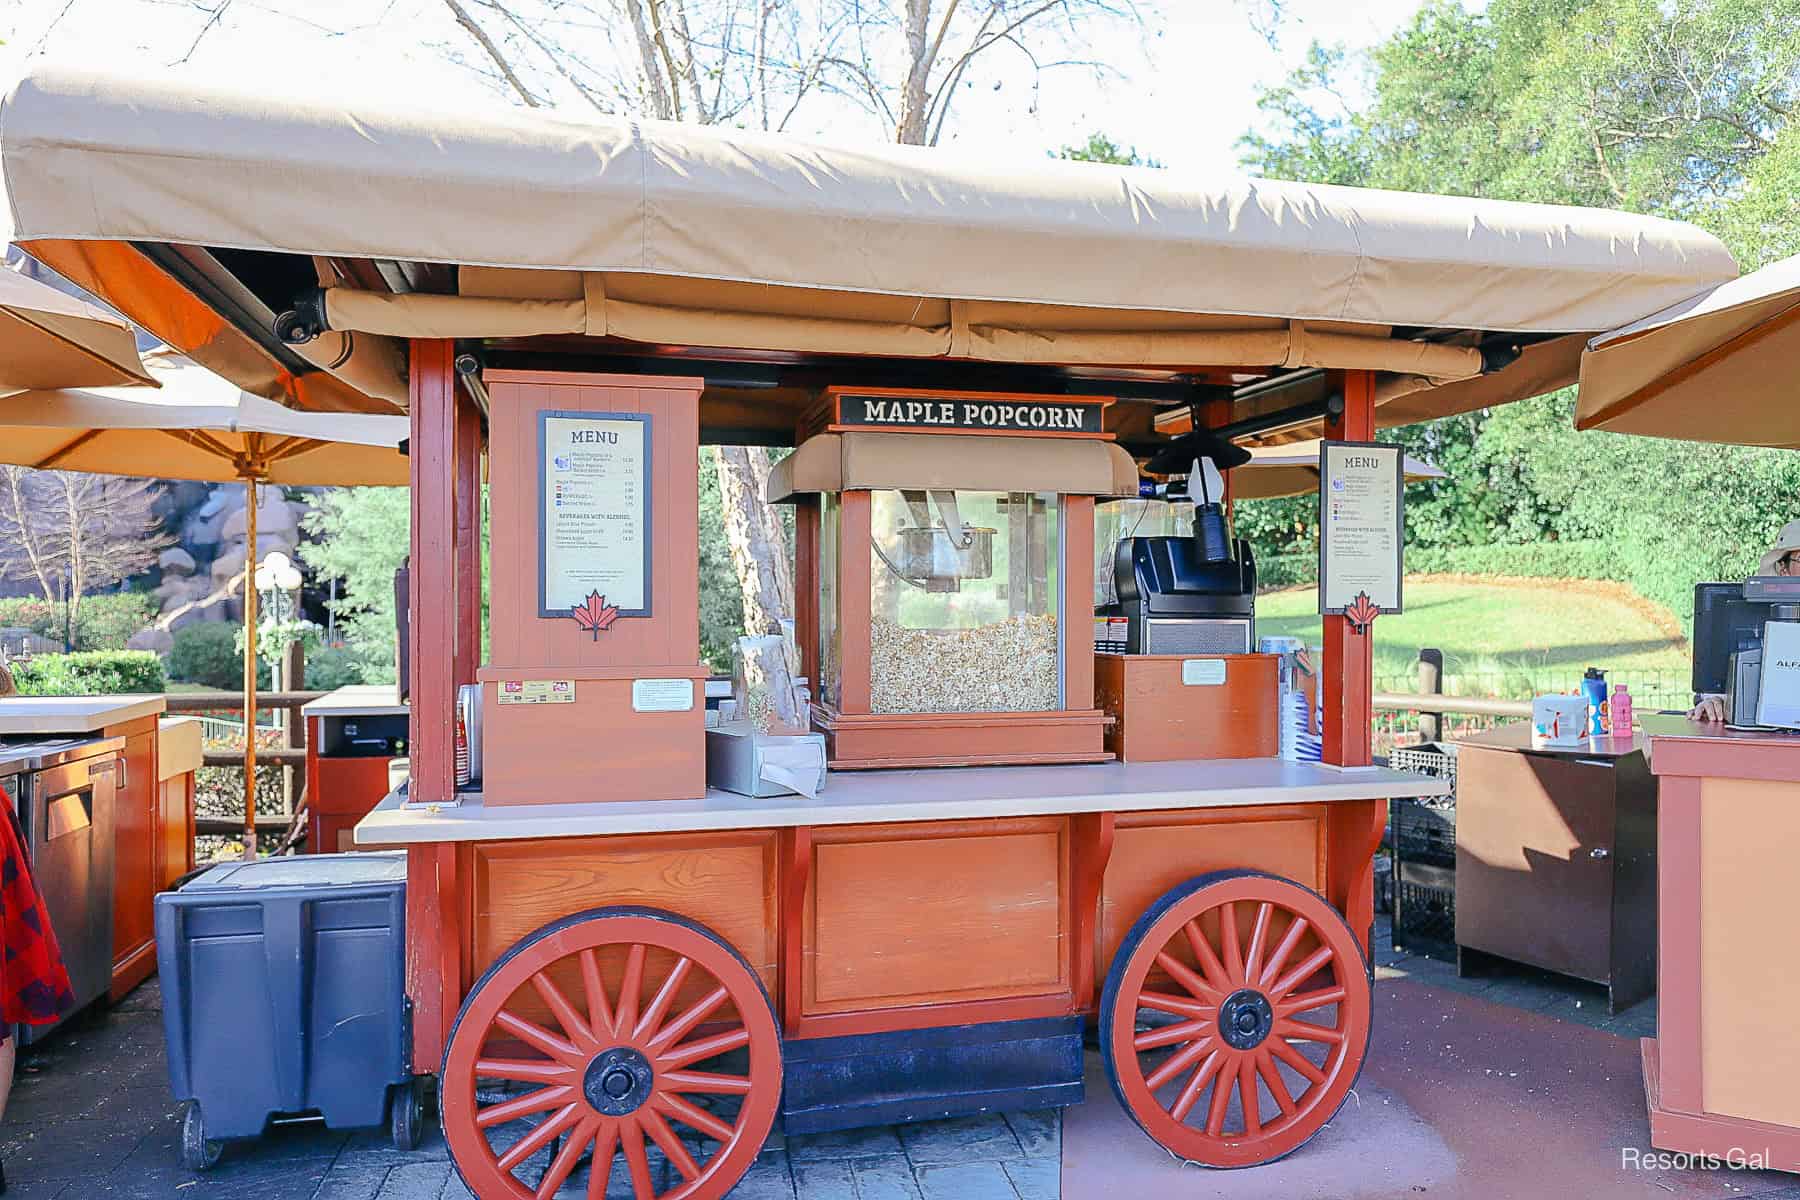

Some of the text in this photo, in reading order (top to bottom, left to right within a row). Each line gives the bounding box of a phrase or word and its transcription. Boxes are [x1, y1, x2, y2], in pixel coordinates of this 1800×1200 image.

[863, 400, 1085, 429] MAPLE POPCORN
[571, 430, 619, 445] MENU
[1344, 457, 1379, 469] MENU
